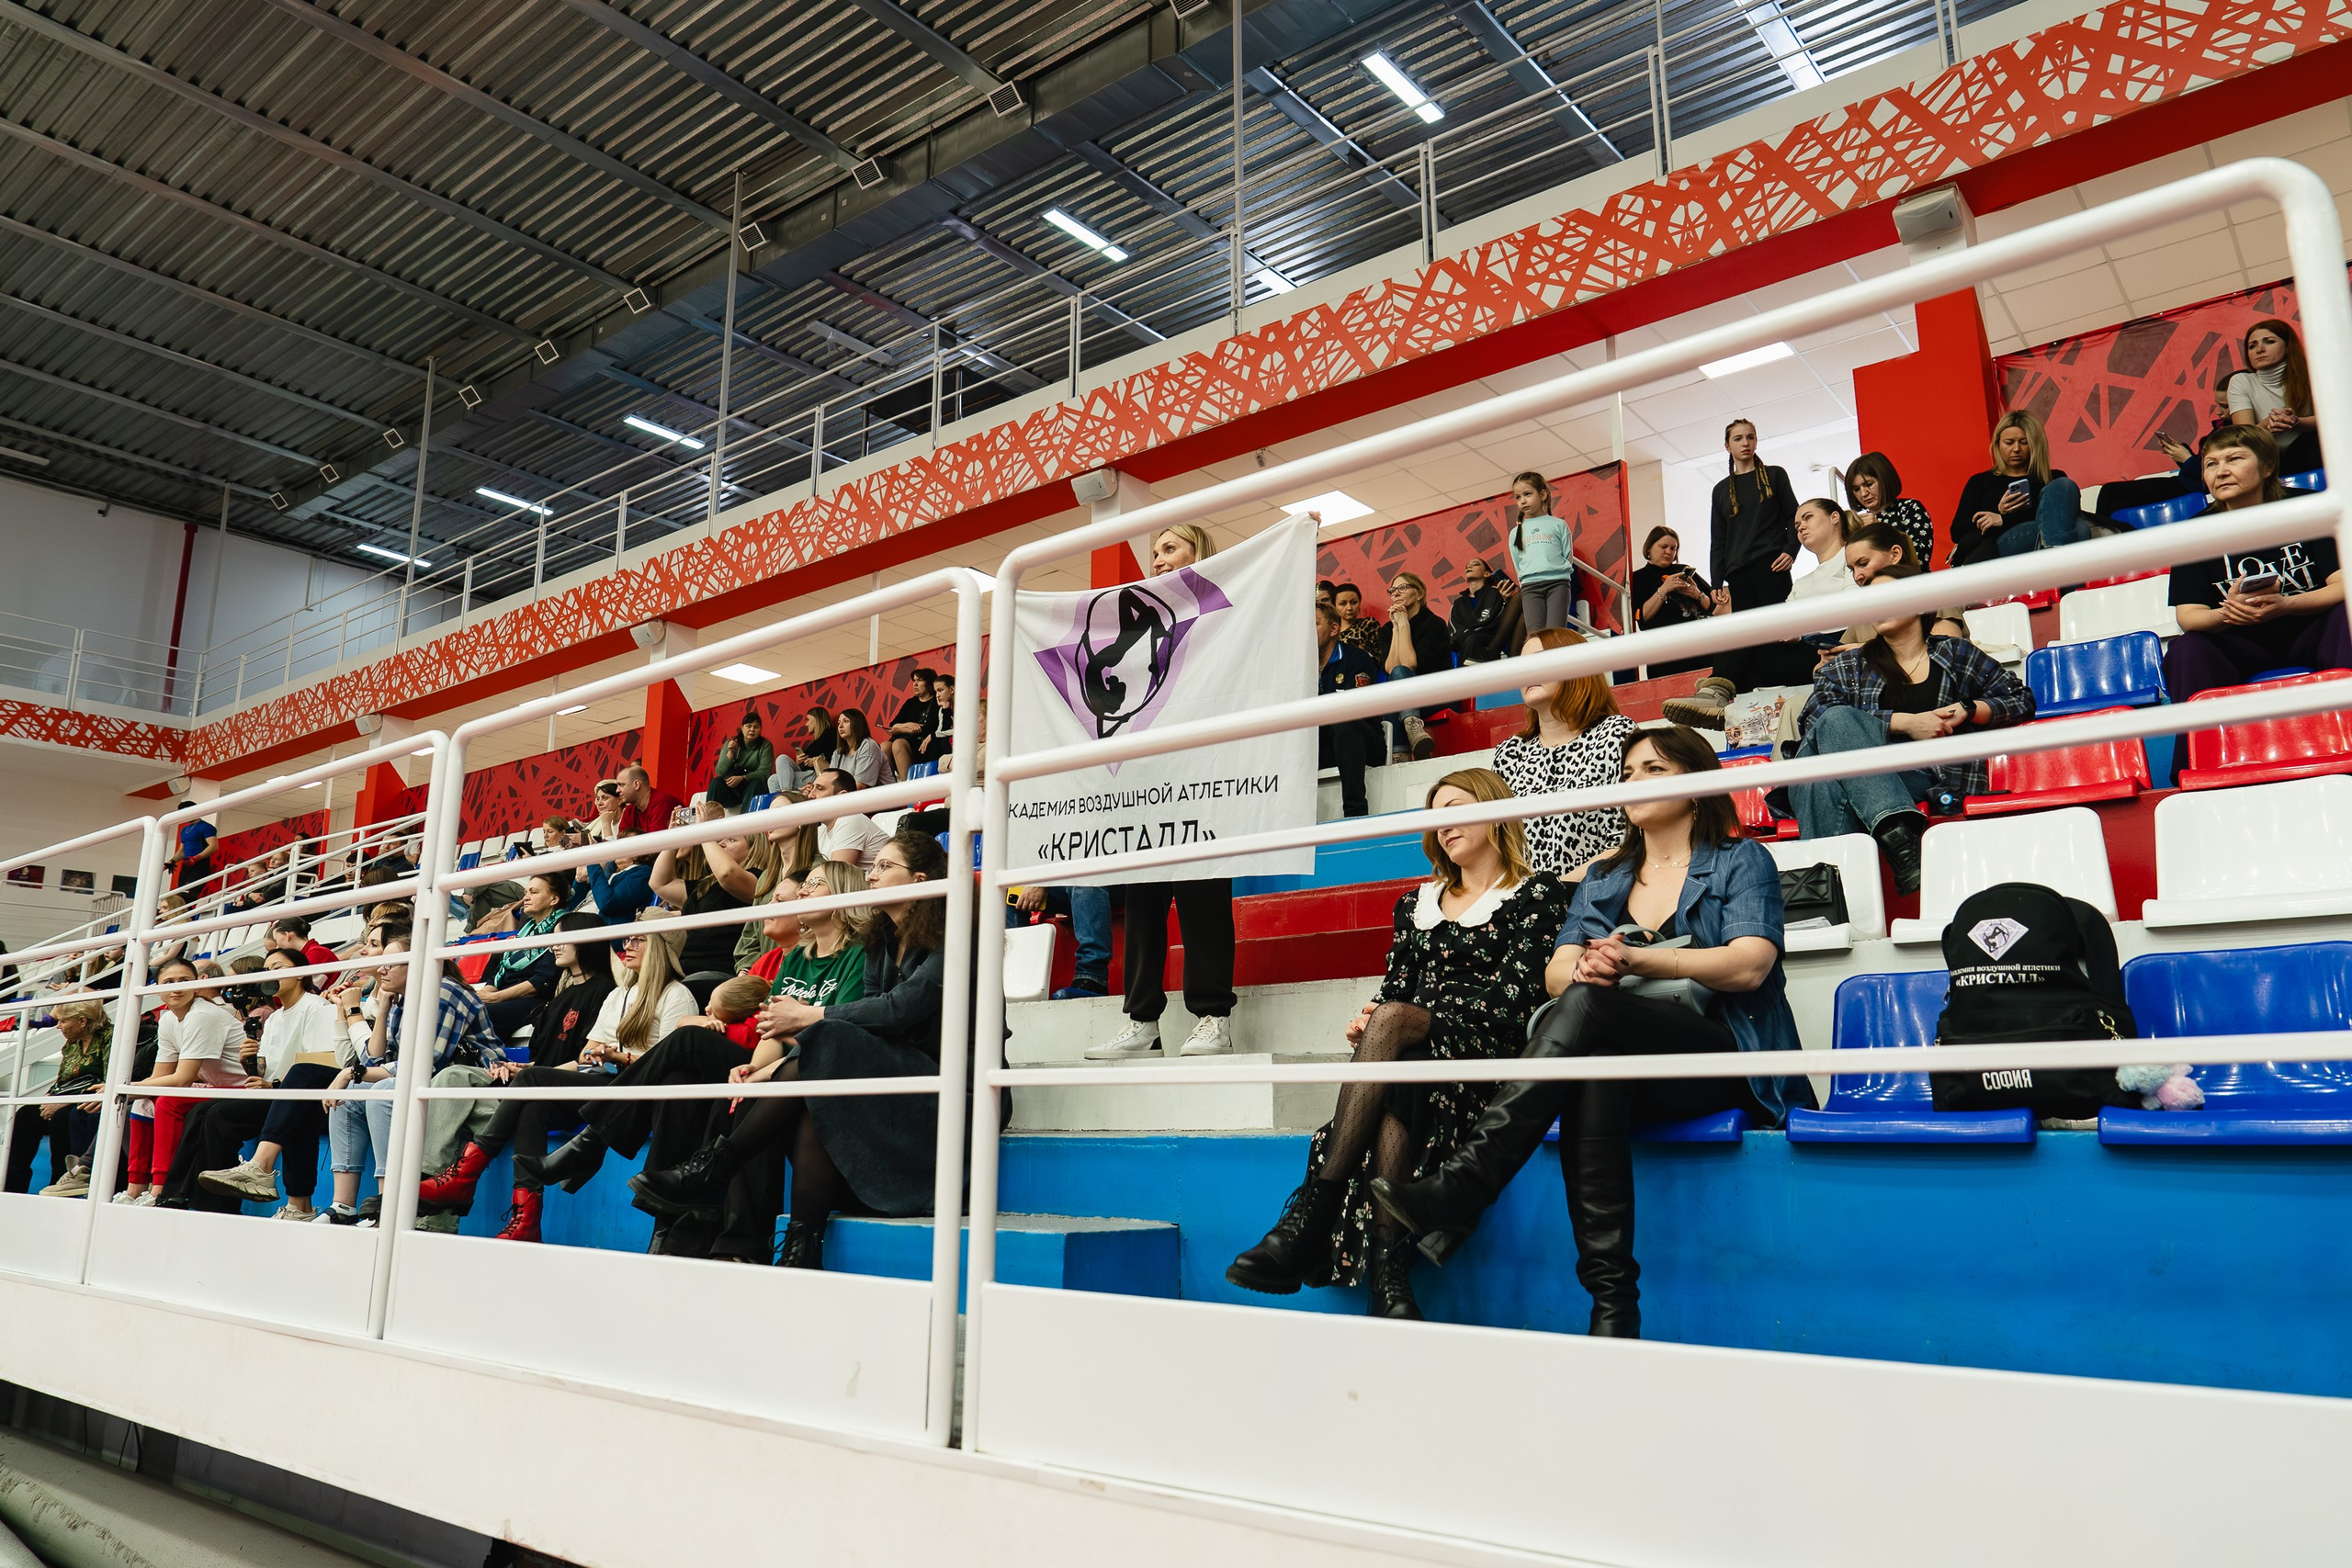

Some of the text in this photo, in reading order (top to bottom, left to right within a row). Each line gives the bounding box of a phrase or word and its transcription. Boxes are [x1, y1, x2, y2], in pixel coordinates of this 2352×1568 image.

[1008, 774, 1279, 819] КАДЕМИЯ ВОЗДУШНОЙ АТЛЕТИКИ
[1037, 819, 1216, 862] «КРИСТАЛЛ»
[1955, 972, 2045, 987] «КРИСТАЛЛ»
[1976, 964, 2020, 974] воздушной
[2022, 964, 2061, 972] атлетики
[1982, 1068, 2033, 1090] СОФИЯ
